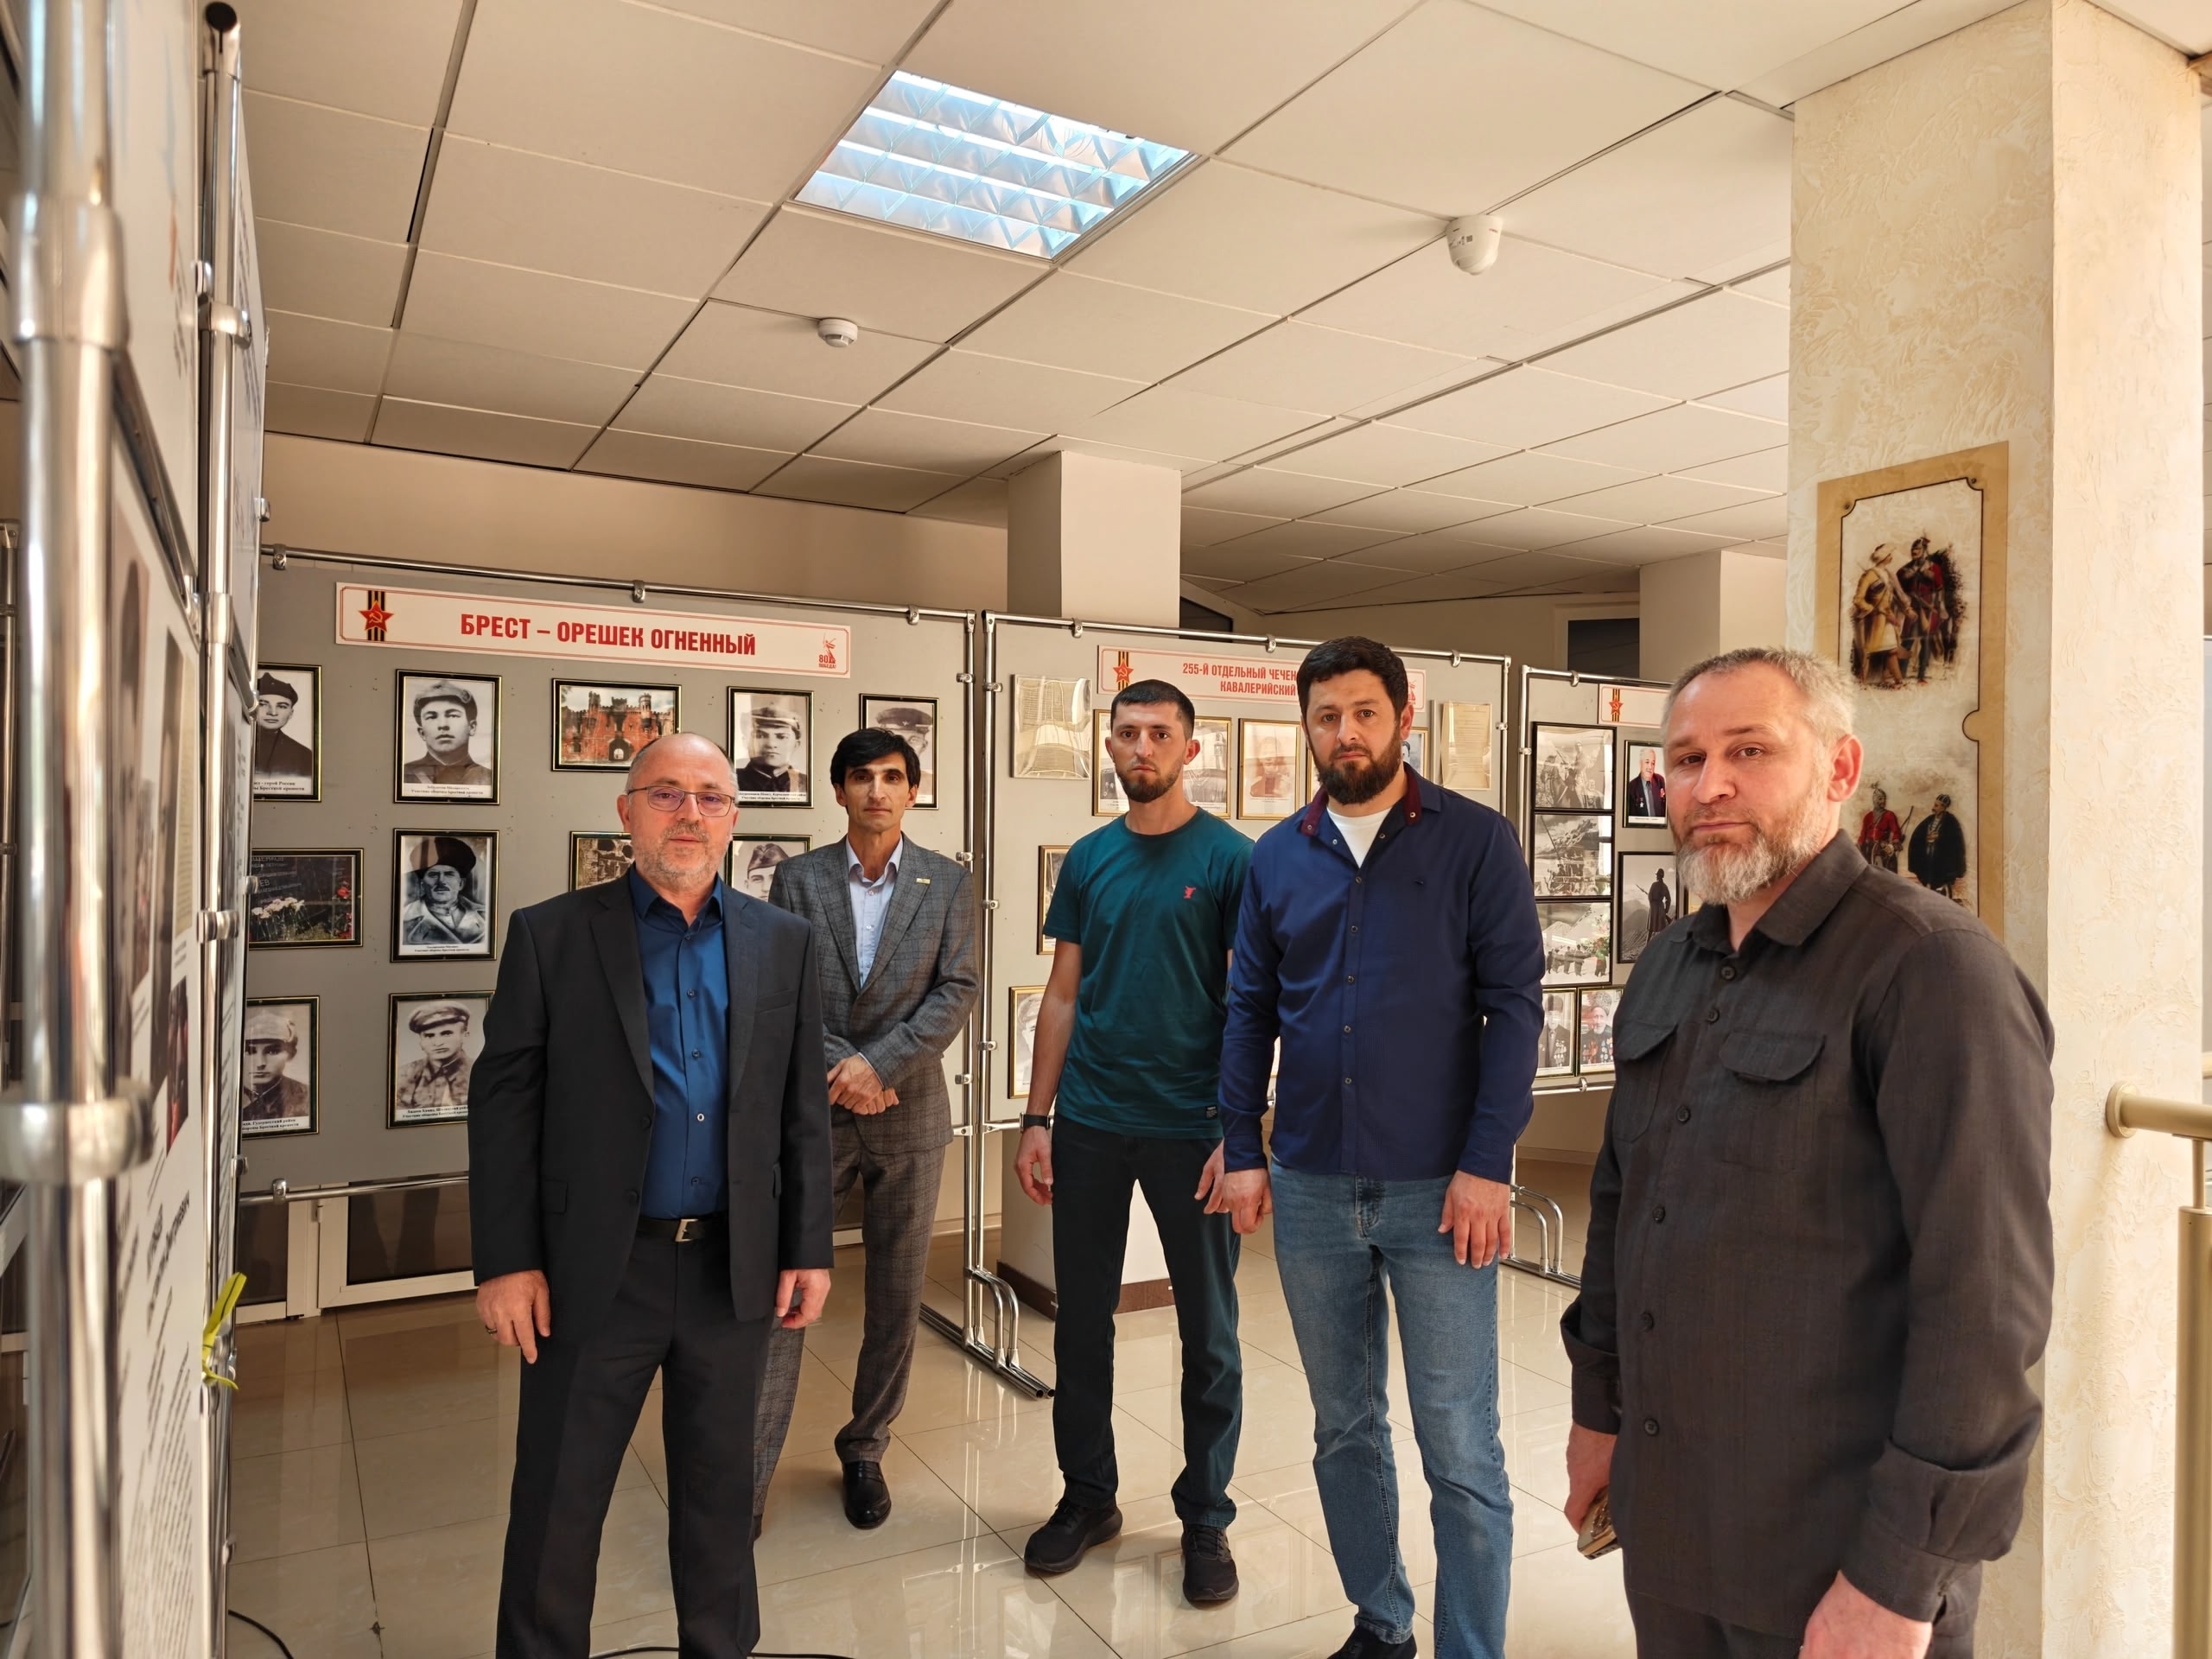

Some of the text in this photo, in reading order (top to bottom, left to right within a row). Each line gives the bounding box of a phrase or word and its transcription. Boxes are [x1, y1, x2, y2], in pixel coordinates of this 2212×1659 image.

[461, 613, 531, 639] БРЕСТ
[557, 621, 644, 647] ОРЕШЕК
[651, 628, 756, 655] ОГНЕННЫЙ
[819, 655, 829, 664] 80
[1183, 663, 1297, 681] 255-Й ОТДЕЛЬНЫЙ ЧЕЧЕН
[1220, 680, 1296, 696] КАВАЛЕРИЙСКИЙ
